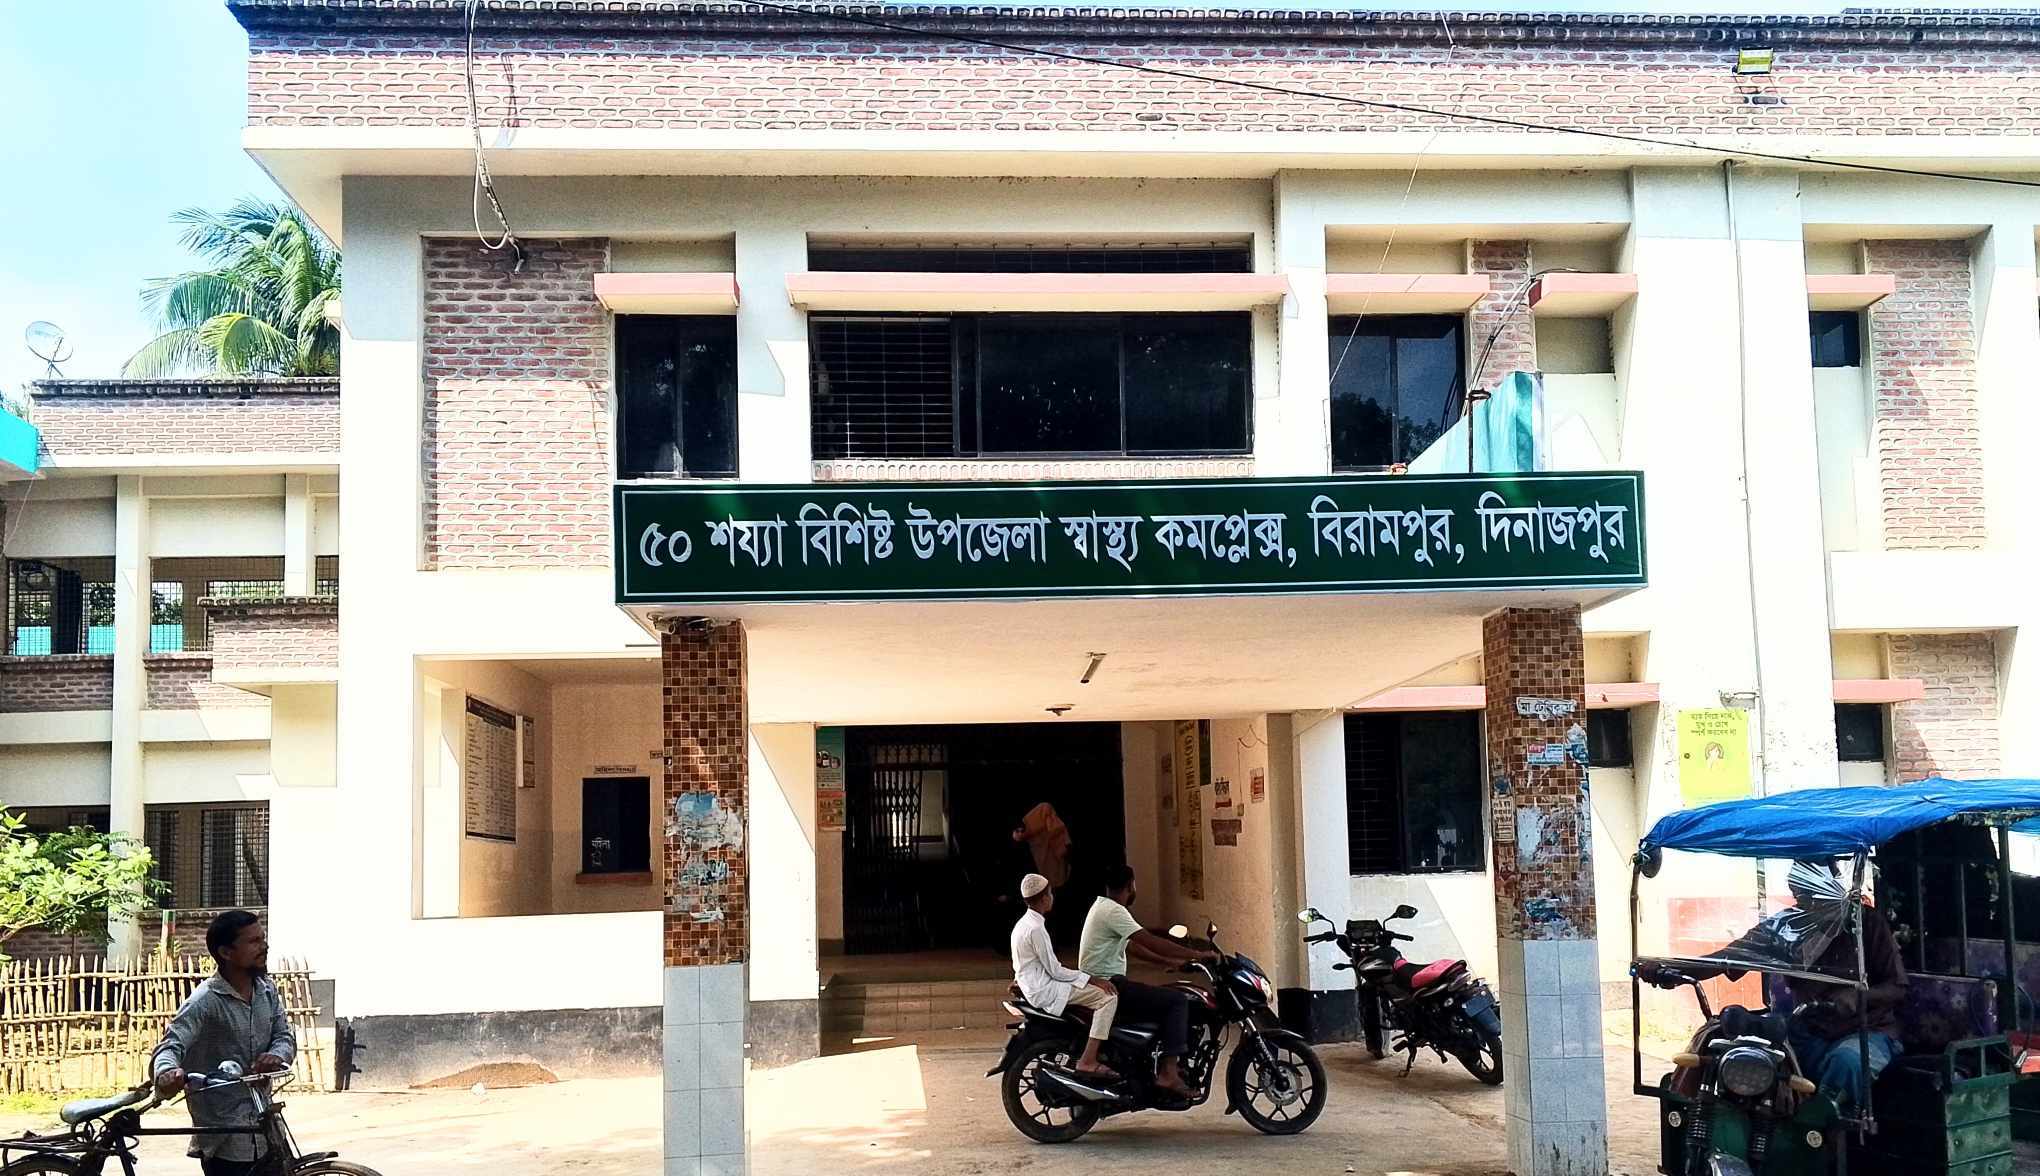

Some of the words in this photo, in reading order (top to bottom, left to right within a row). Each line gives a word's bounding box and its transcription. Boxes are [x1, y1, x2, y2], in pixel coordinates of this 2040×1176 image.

[639, 522, 692, 567] ৫০
[704, 512, 789, 568] শয্যা
[794, 502, 896, 567] বিশিষ্ট
[904, 501, 1052, 564] উপজেলা
[1057, 509, 1145, 573] স্বাস্থ্য
[1149, 508, 1297, 568] কমপ্লেক্স,
[1306, 494, 1465, 568] বিরামপুর,
[1473, 490, 1629, 564] দিনাজপুর
